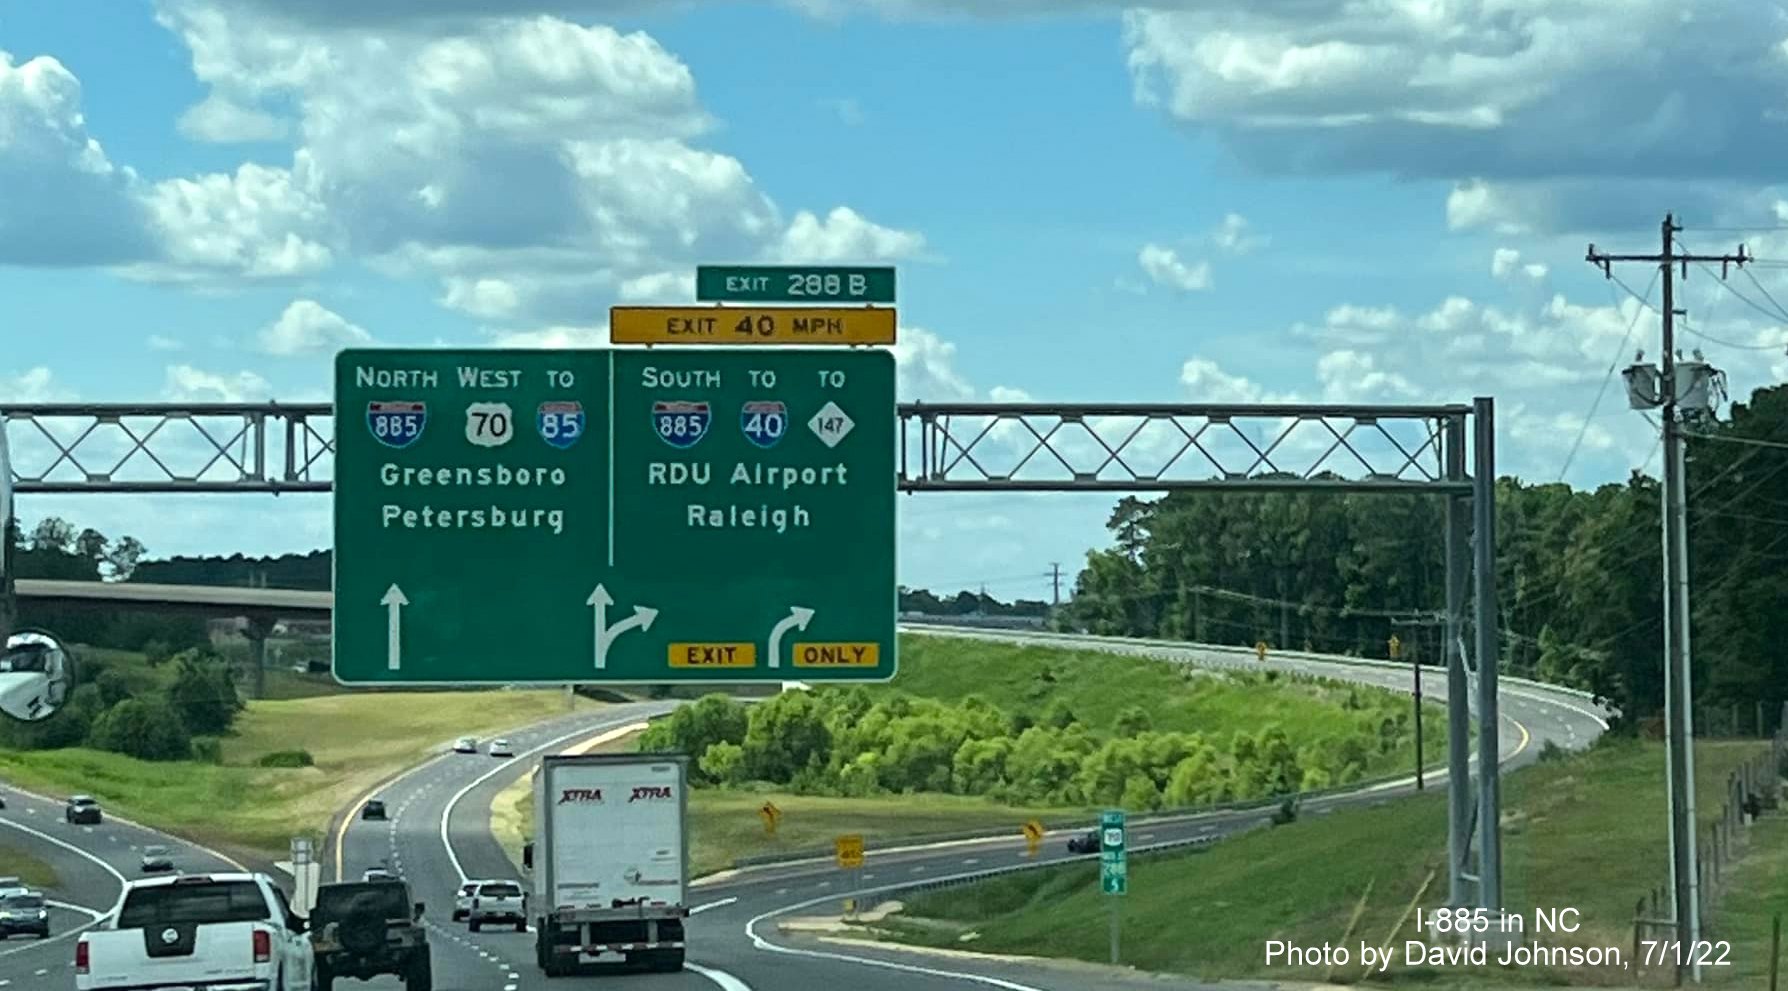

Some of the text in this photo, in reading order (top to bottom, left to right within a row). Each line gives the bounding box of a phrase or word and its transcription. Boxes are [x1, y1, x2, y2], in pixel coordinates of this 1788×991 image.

[726, 274, 867, 296] EXIT 288 B
[667, 315, 844, 337] EXIT 40 MPH
[356, 366, 575, 388] NORTH WEST TO
[642, 366, 846, 388] SOUTH TO TO
[375, 412, 579, 438] 885 70 85
[660, 413, 844, 438] 885 40 147
[380, 463, 566, 486] Greensboro
[648, 462, 848, 490] RDU Airport
[382, 504, 564, 534] Petersburg
[687, 504, 810, 534] Raleigh
[686, 646, 866, 664] EXIT ONLY
[558, 788, 602, 805] XTRA
[628, 786, 672, 803] XTRA
